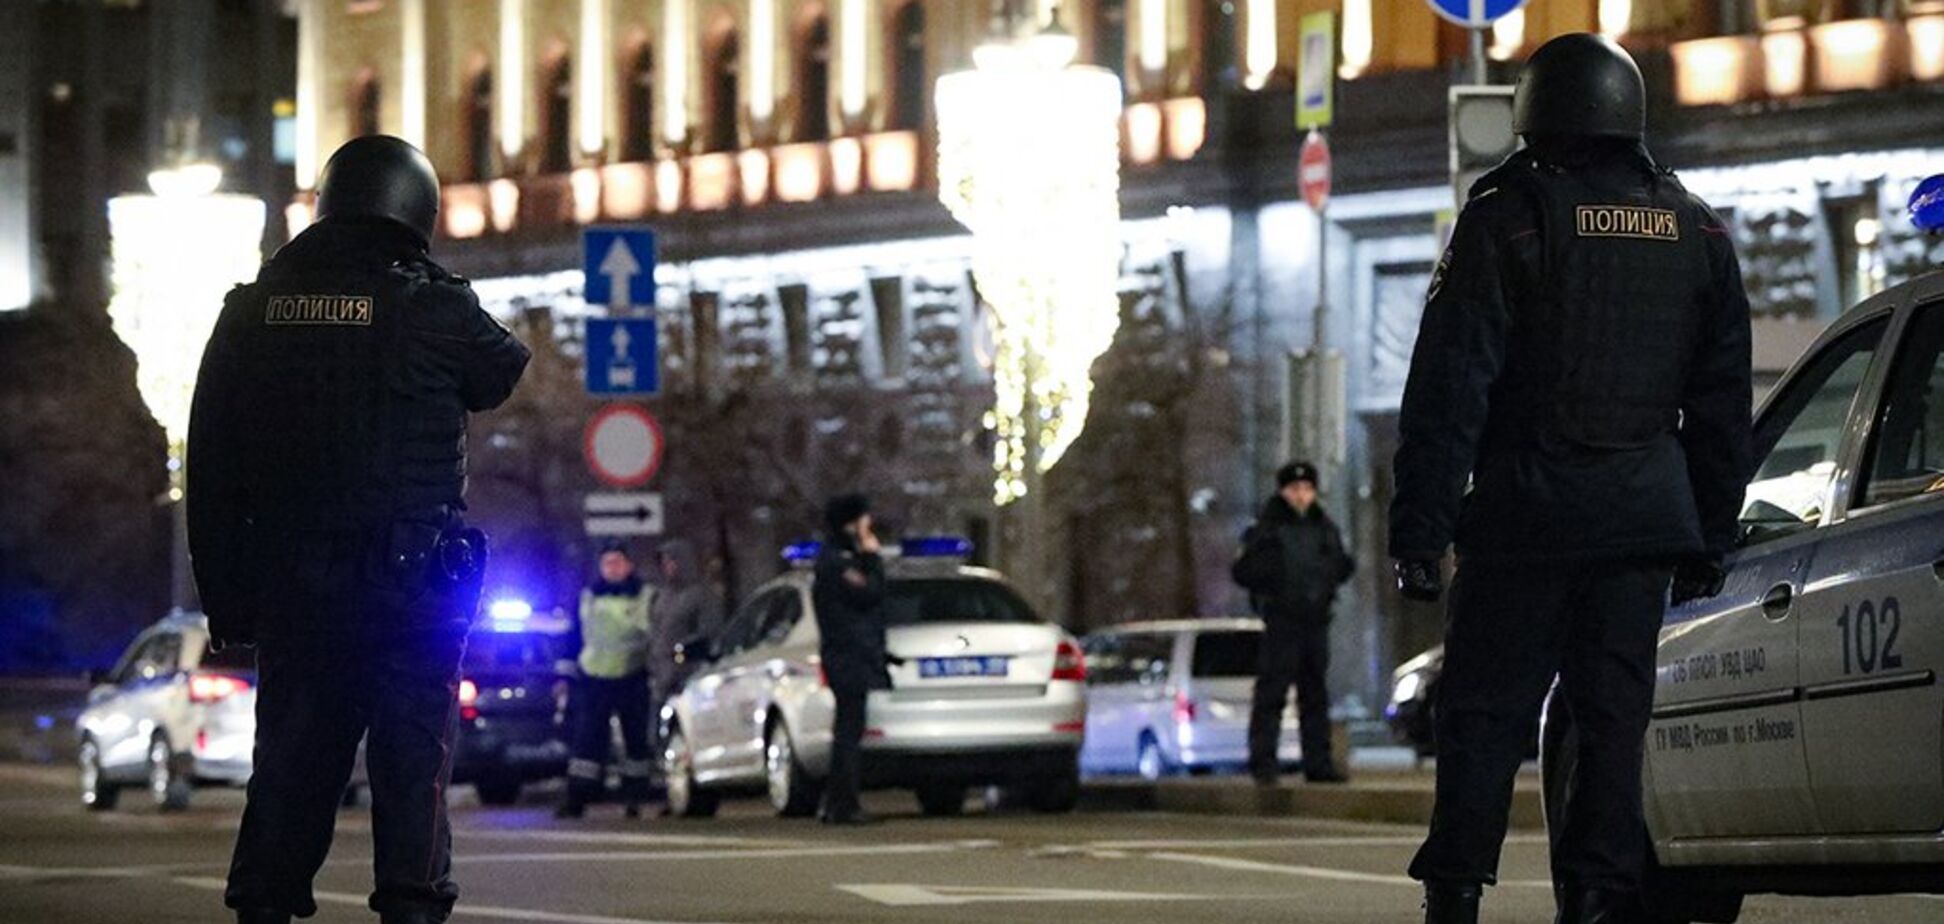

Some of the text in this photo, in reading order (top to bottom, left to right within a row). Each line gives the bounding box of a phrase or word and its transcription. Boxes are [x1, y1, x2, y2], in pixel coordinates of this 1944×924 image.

[1581, 209, 1677, 236] ПОЛИЦИЯ
[269, 298, 369, 322] ПОЛИЦИЯ
[1837, 596, 1903, 675] 102
[1720, 651, 1742, 680] УВД
[1743, 646, 1766, 677] ЦАО
[1656, 727, 1666, 751] ГУ
[1669, 724, 1693, 753] МВД
[1693, 723, 1729, 746] России
[1733, 724, 1746, 744] по
